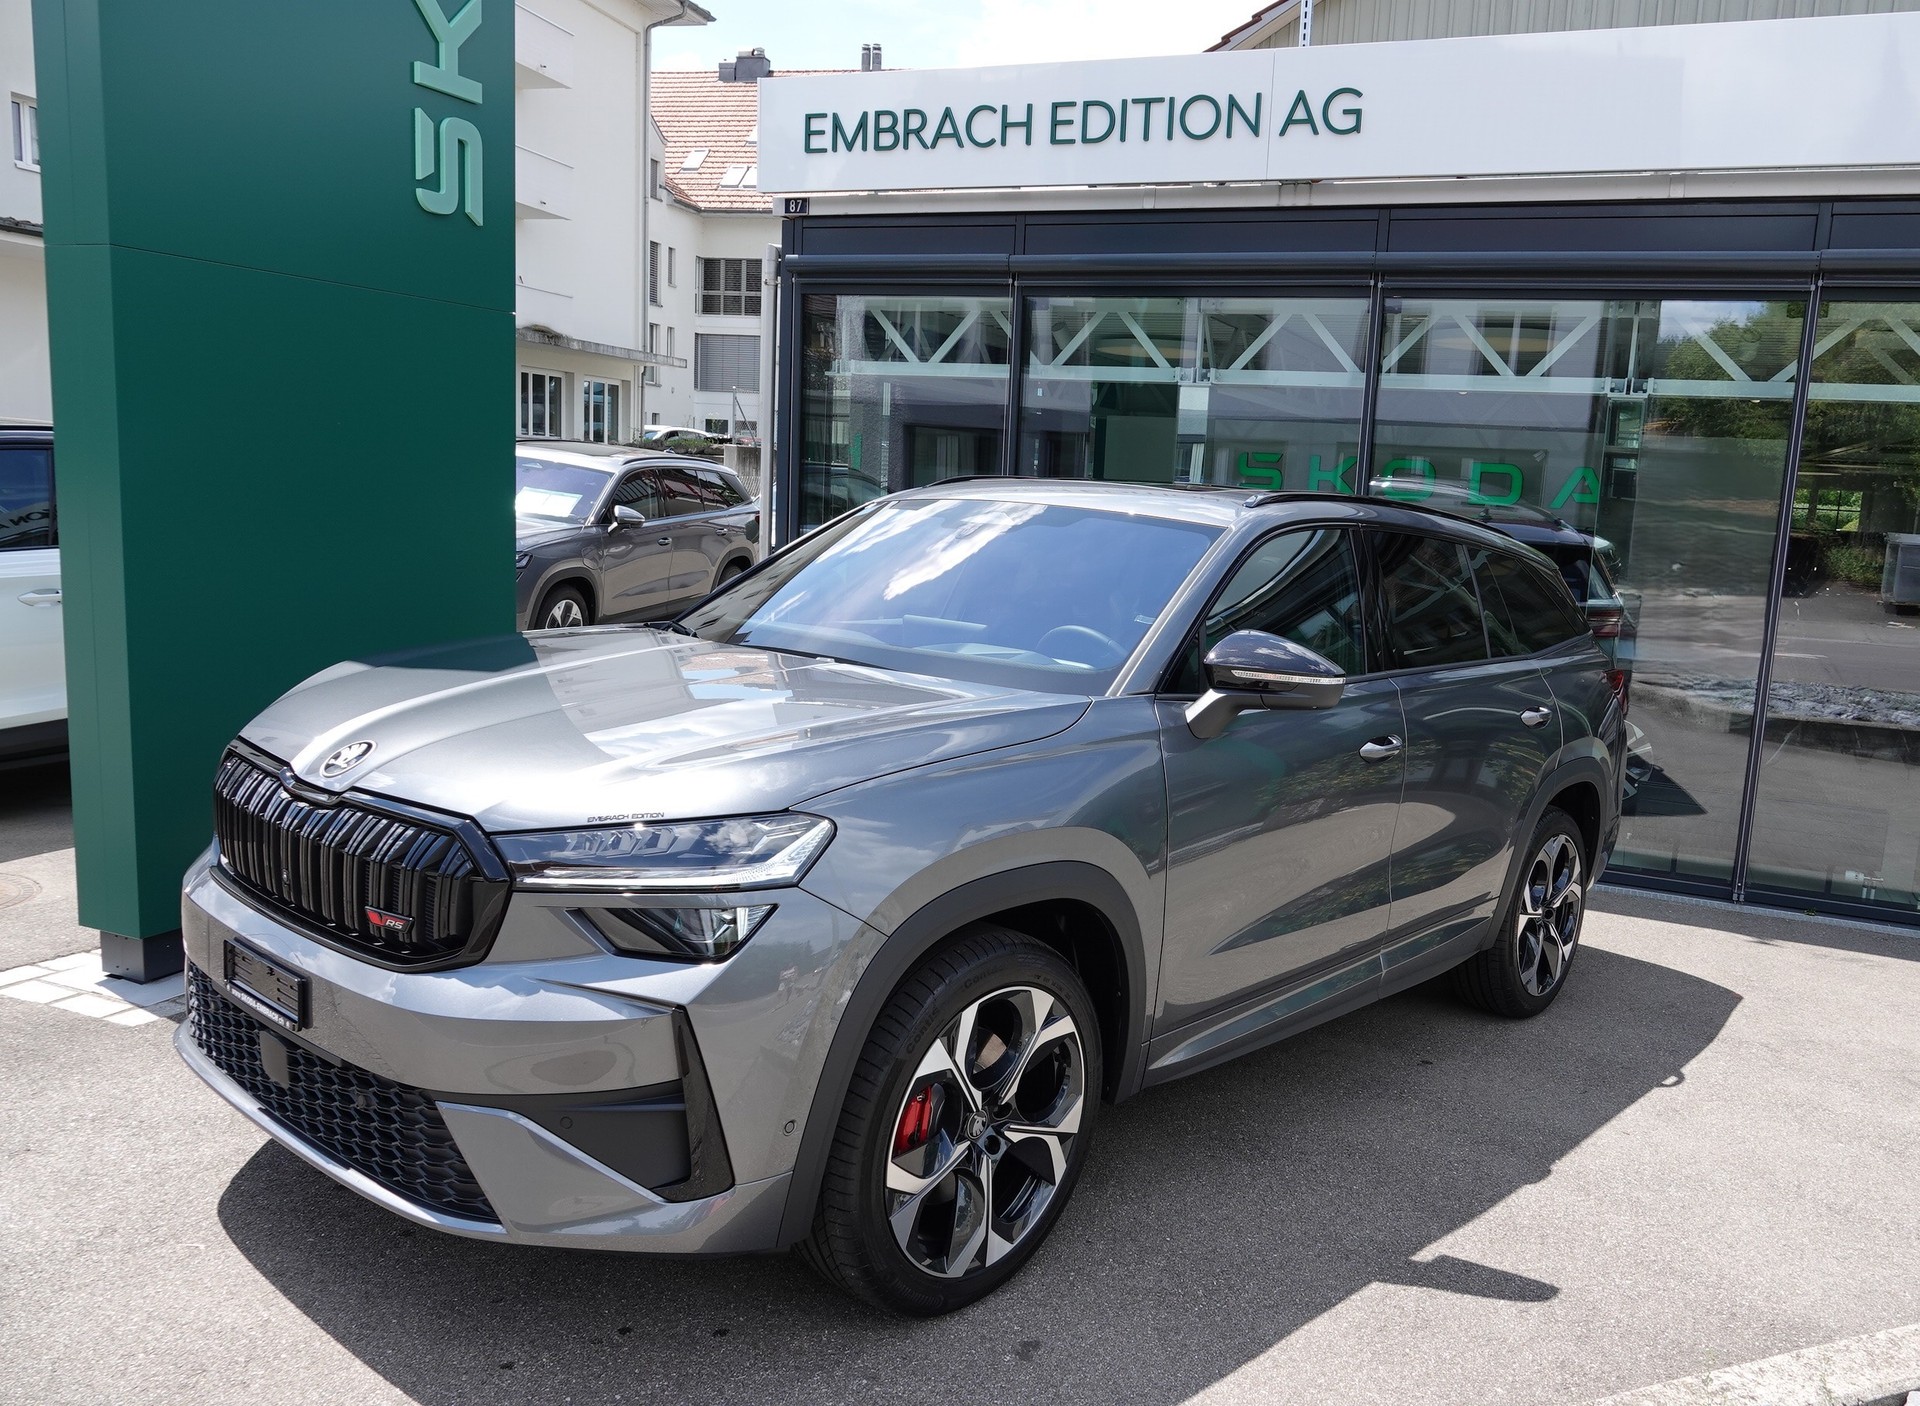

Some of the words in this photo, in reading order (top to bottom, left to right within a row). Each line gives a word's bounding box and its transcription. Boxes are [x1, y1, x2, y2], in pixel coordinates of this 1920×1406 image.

[803, 103, 1033, 154] EMBRACH
[1049, 91, 1261, 145] EDITION
[1279, 87, 1364, 137] AG
[789, 199, 803, 213] 87
[631, 811, 665, 820] EDITION
